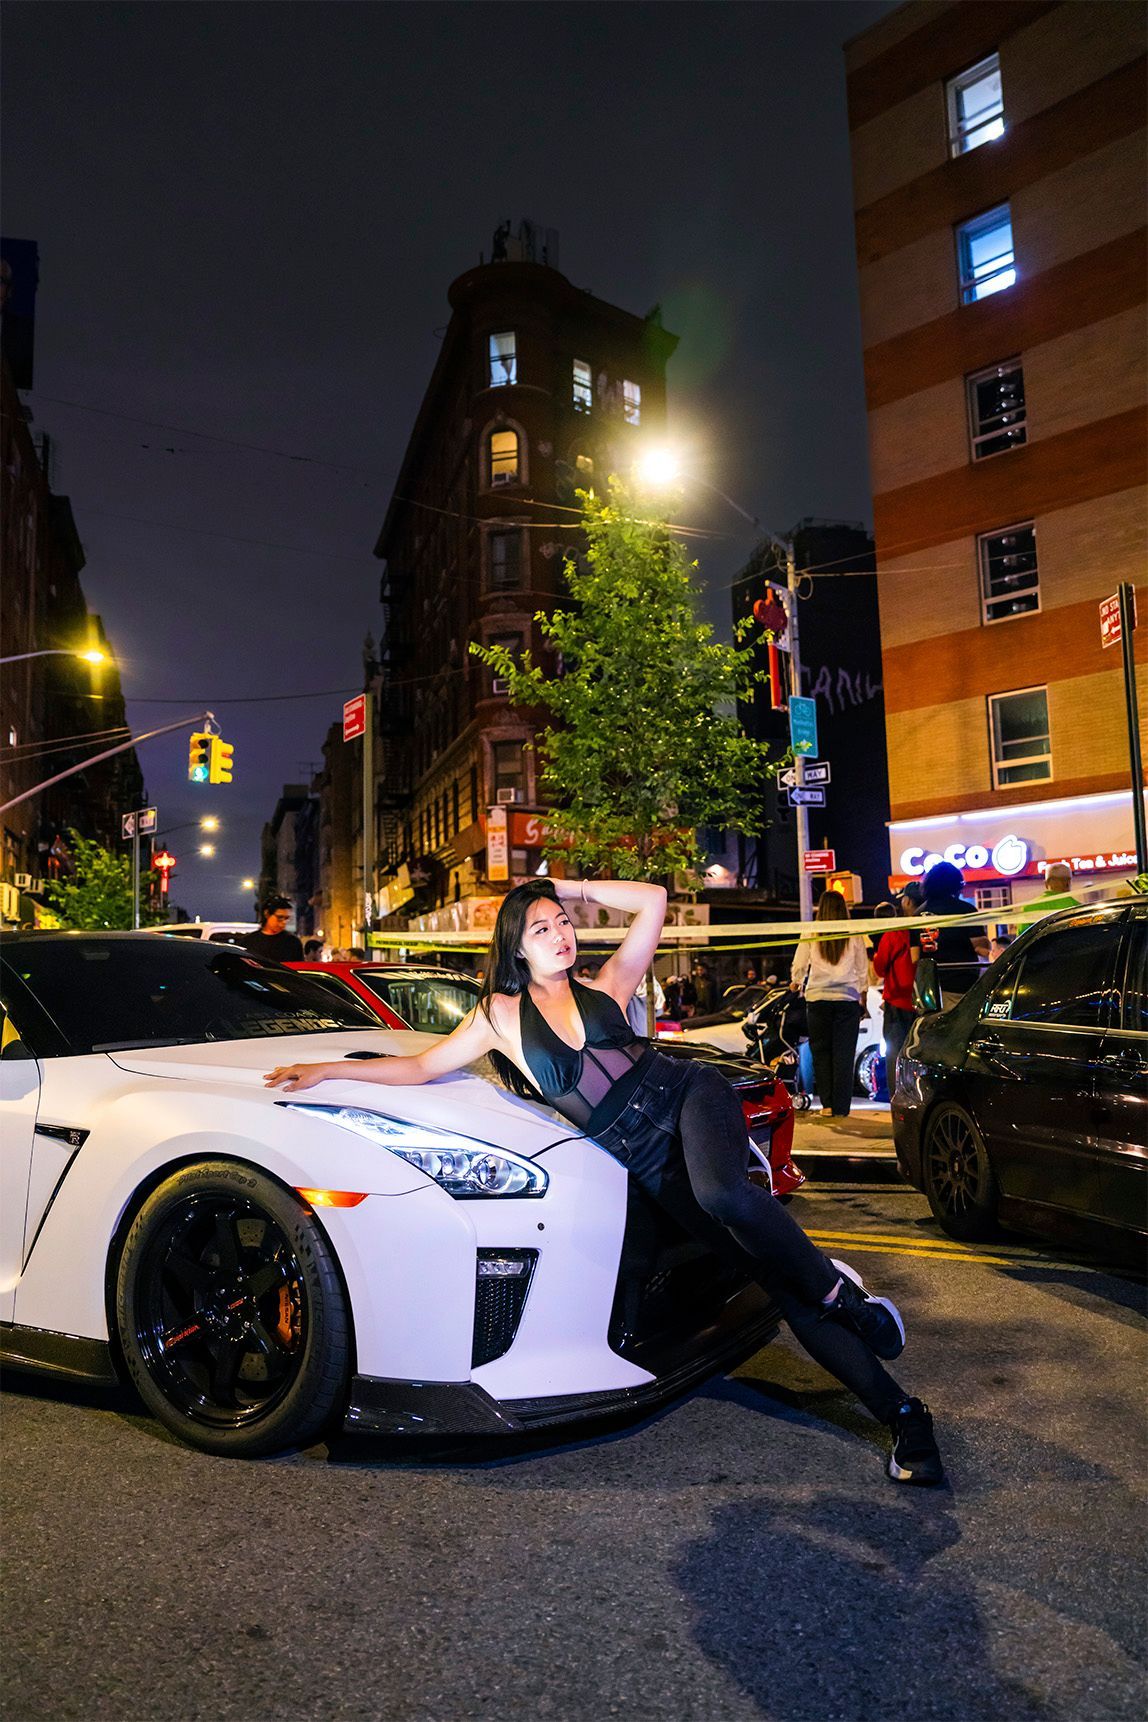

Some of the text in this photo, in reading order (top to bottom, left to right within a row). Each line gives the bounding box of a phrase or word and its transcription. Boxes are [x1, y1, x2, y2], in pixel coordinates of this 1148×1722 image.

[808, 770, 822, 779] WAY
[1071, 858, 1094, 870] Tea
[1095, 855, 1106, 867] &
[230, 1171, 247, 1185] Cup
[246, 1178, 258, 1189] 2
